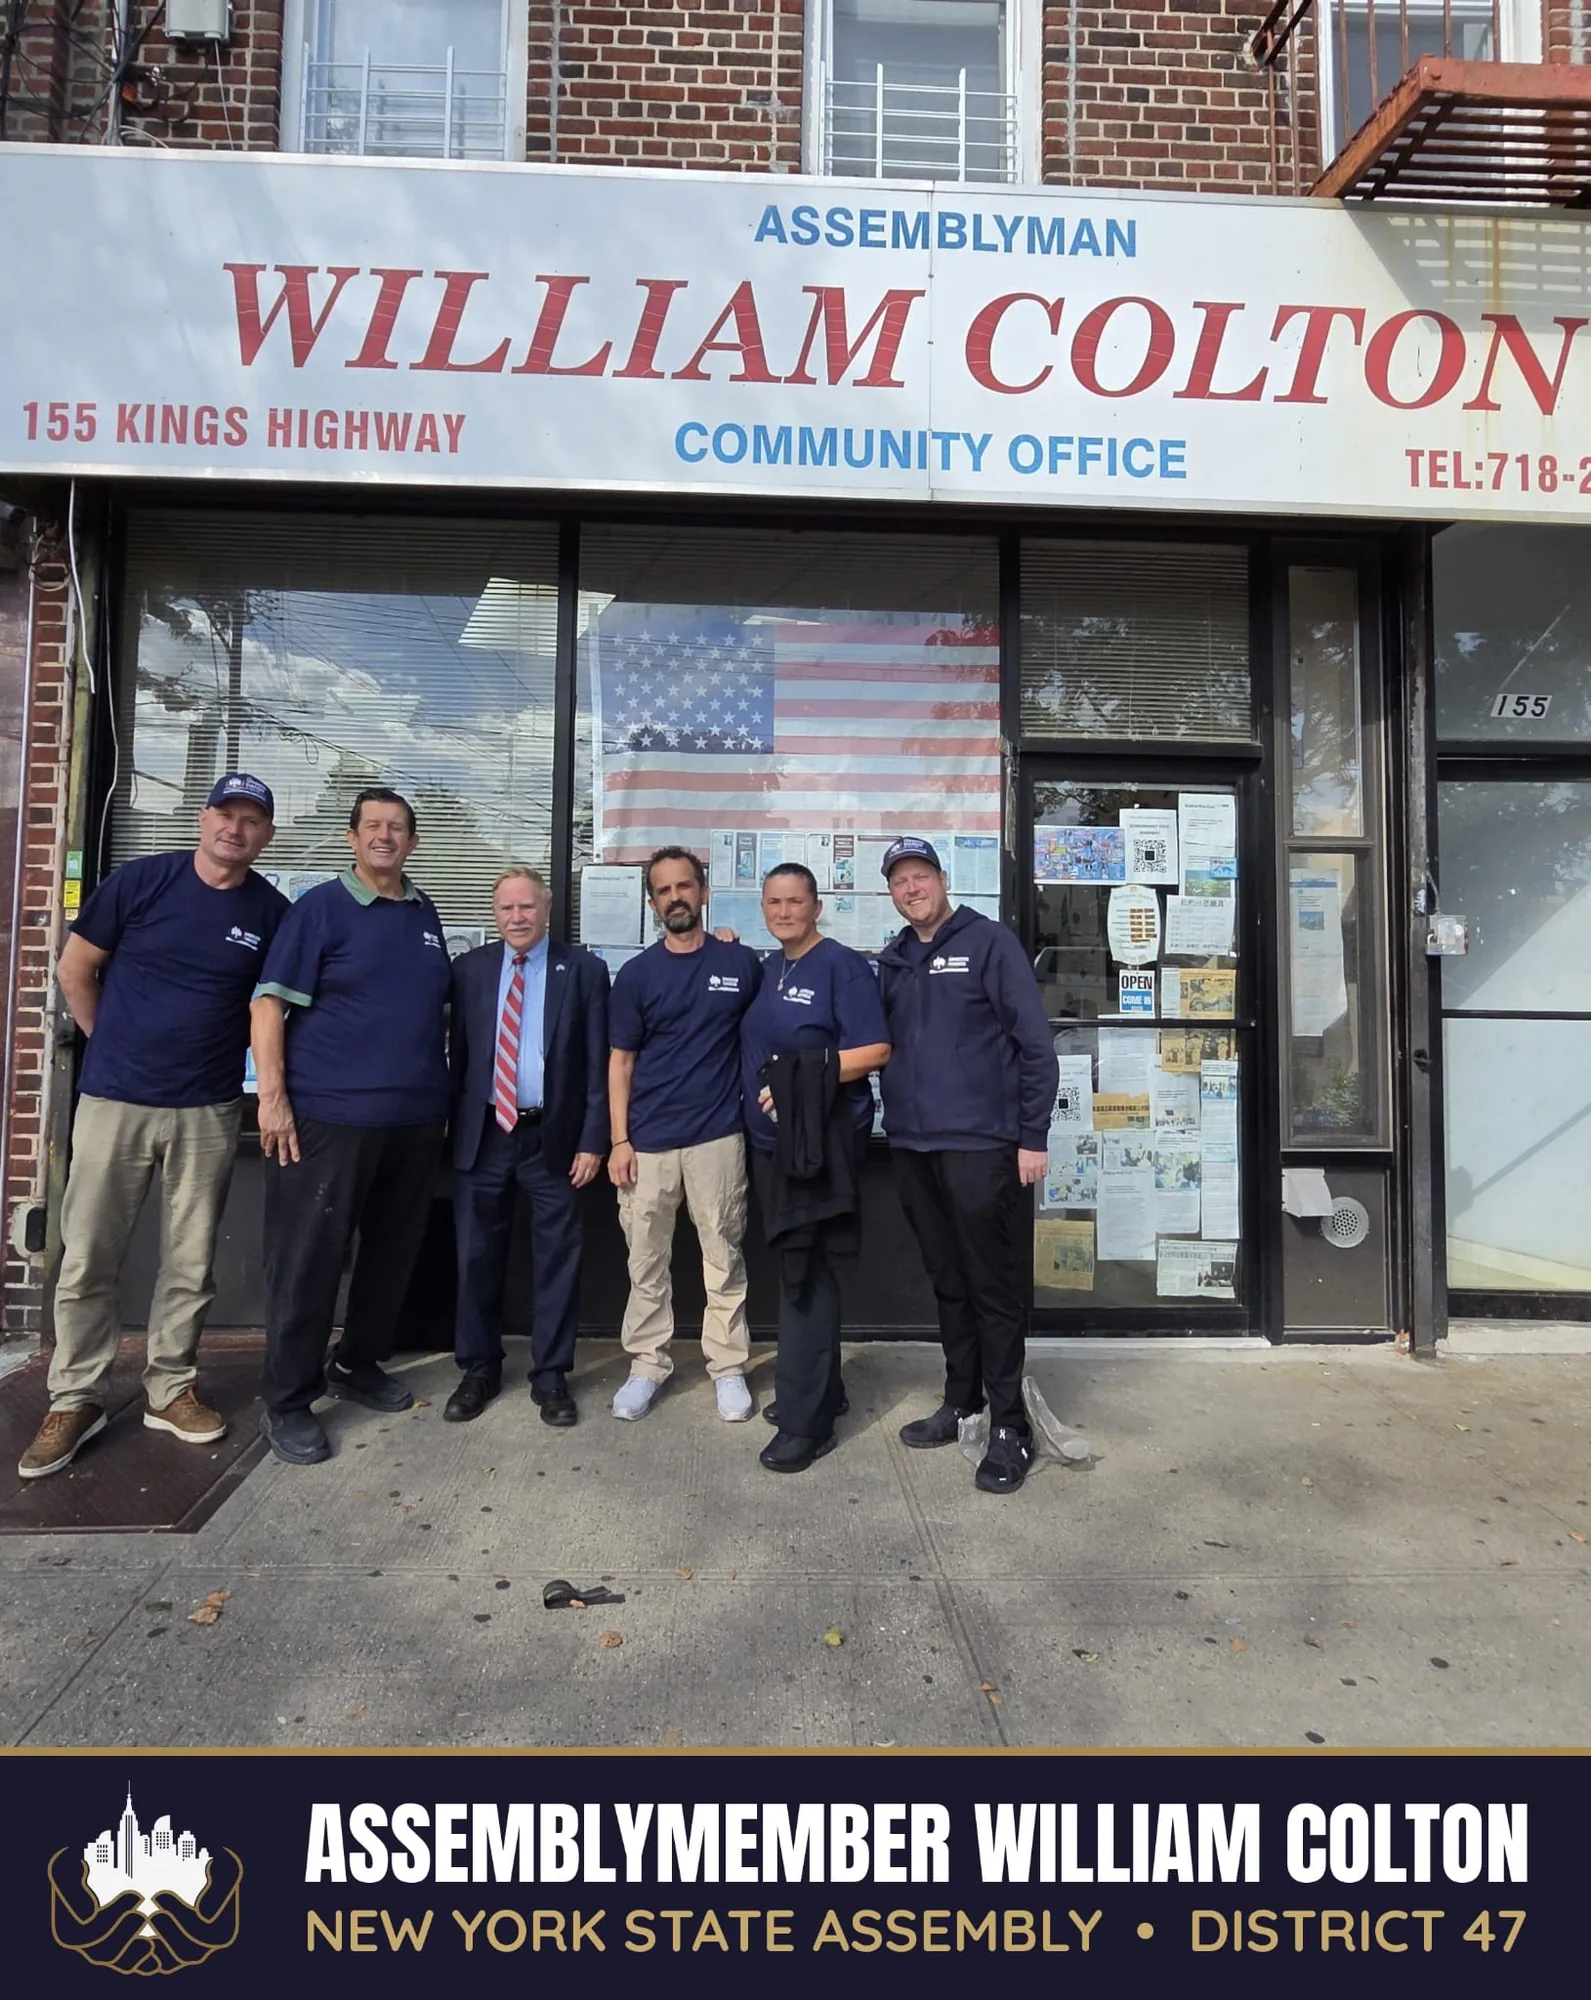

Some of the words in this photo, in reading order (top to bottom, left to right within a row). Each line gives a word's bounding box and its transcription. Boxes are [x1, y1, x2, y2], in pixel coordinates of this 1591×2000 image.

[754, 203, 1138, 259] ASSEMBLYMAN
[223, 263, 926, 388] WILLIAM
[965, 291, 1589, 416] COLTON
[23, 402, 98, 443] 155
[116, 404, 248, 447] KINGS
[266, 408, 467, 454] HIGHWAY
[673, 420, 993, 474] COMMUNITY
[1007, 433, 1188, 480] OFFICE
[1497, 694, 1548, 717] 155
[1121, 975, 1152, 989] OPEN
